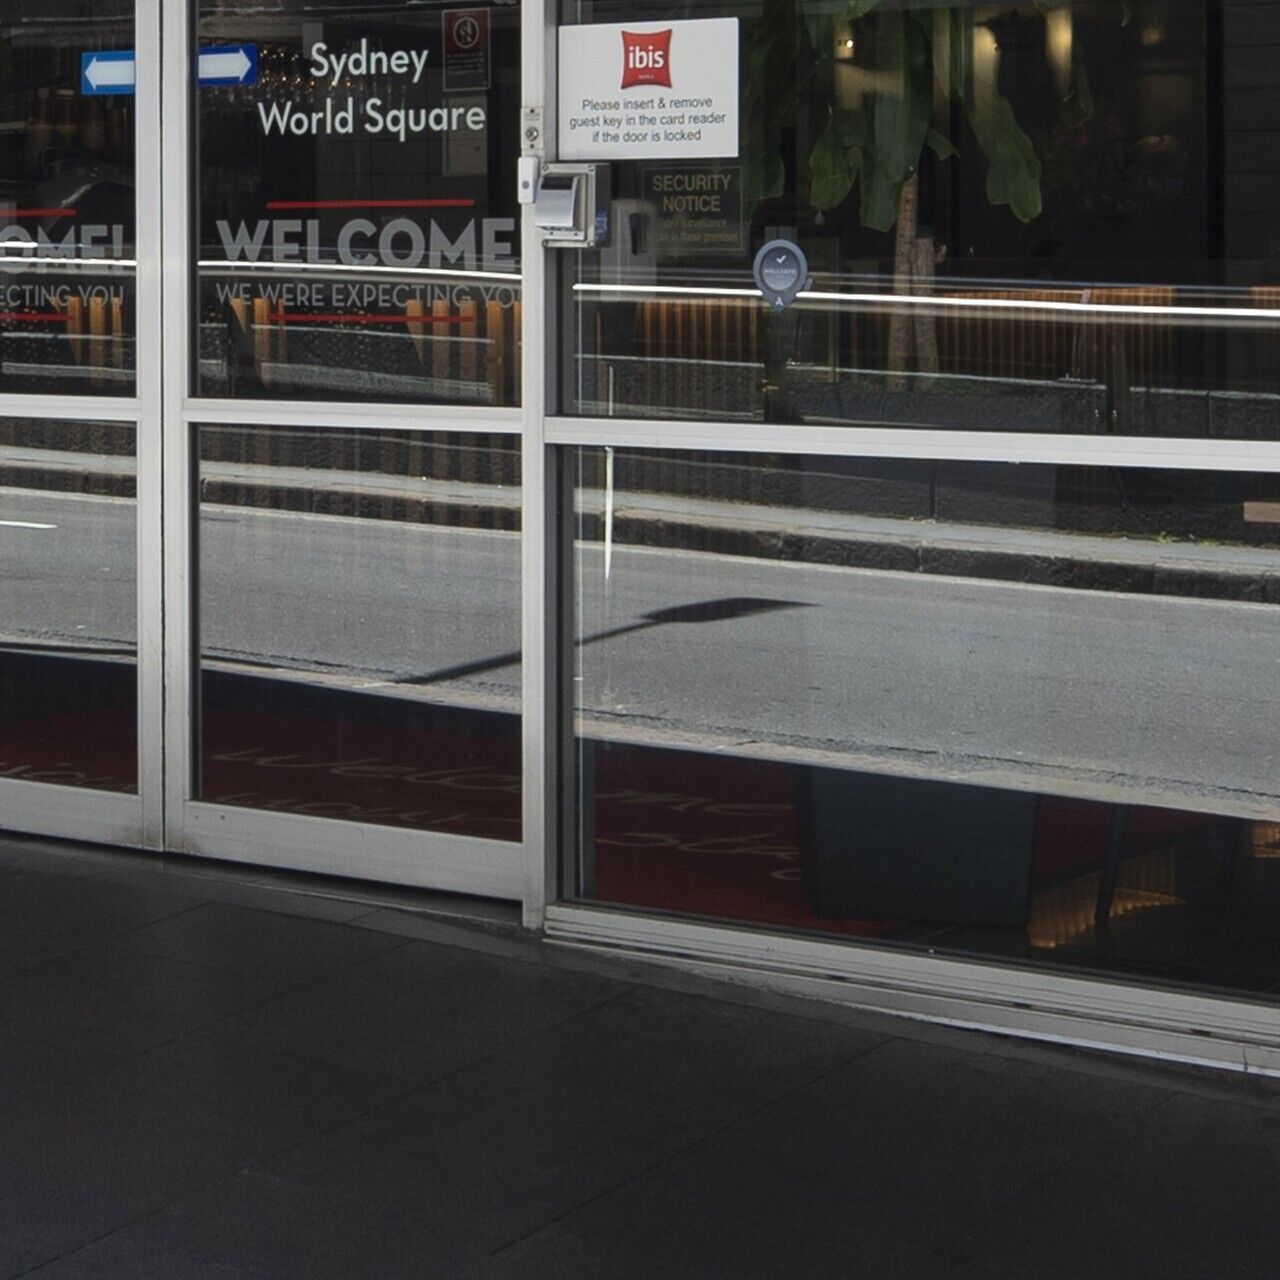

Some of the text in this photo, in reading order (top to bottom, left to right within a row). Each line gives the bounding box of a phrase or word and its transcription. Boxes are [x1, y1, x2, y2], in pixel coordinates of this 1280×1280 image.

[310, 38, 428, 83] Sydney
[628, 45, 664, 69] ibis
[582, 97, 712, 111] Please insert & remove
[257, 96, 486, 142] World Square
[570, 113, 726, 129] guest key in the card reader
[592, 129, 702, 143] if the door is locked
[653, 174, 732, 191] SECURITY
[663, 195, 721, 212] NOTICE
[78, 285, 124, 307] YOU
[216, 283, 521, 308] WE WERE EXPECTING YO
